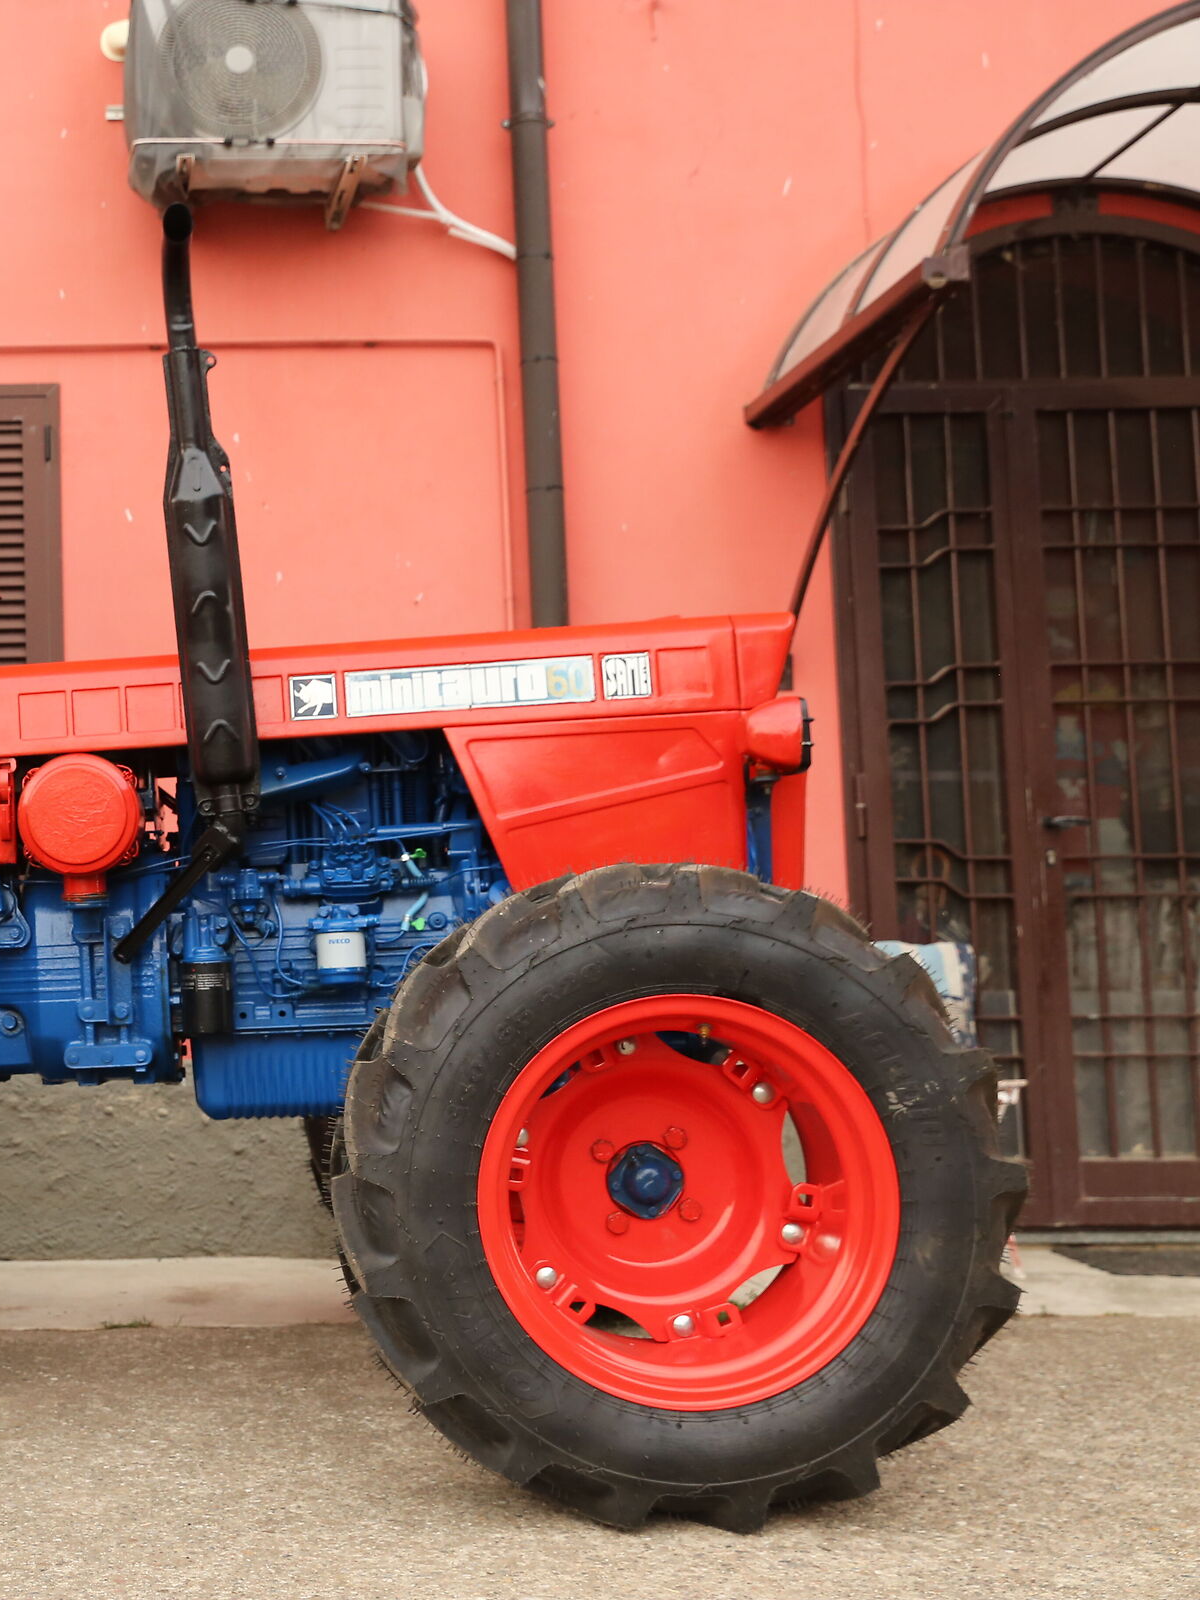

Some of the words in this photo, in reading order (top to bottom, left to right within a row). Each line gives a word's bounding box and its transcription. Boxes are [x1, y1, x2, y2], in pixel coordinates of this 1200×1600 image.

[350, 664, 546, 714] minitauro
[547, 661, 591, 698] 60
[605, 656, 648, 697] SAME
[328, 937, 351, 945] IVECO
